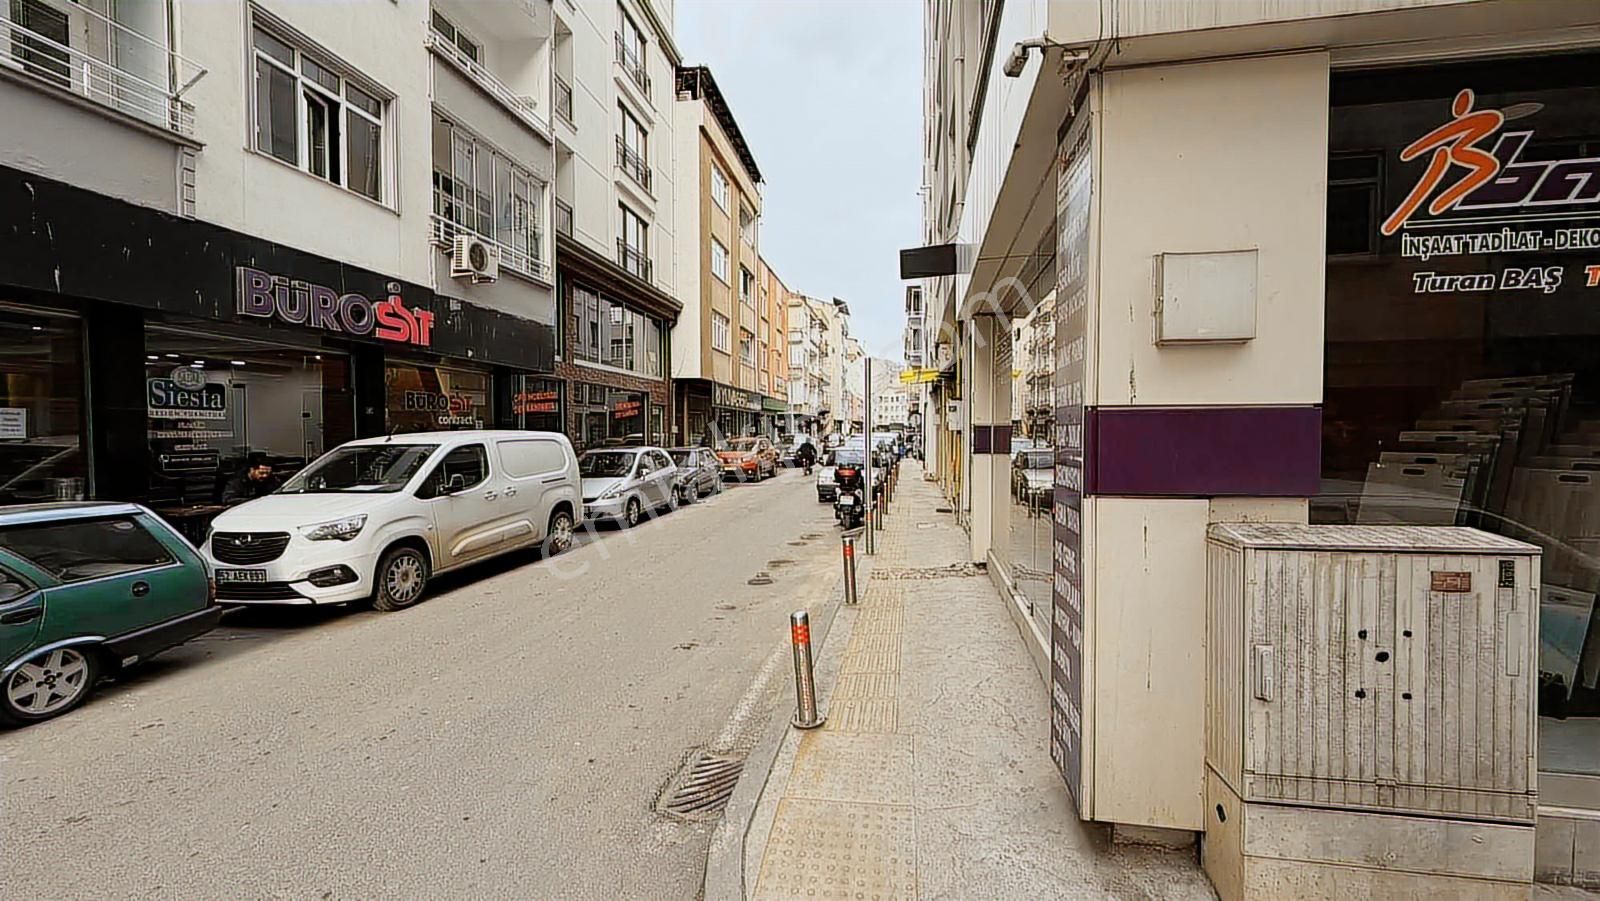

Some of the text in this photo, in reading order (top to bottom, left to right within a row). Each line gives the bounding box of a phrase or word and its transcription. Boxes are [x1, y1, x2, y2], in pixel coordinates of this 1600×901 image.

[1402, 233, 1465, 261] İNŞAAT
[1468, 227, 1542, 253] TADİLAT
[1413, 272, 1495, 293] Turan
[1500, 266, 1563, 293] BAŞ
[151, 381, 223, 408] Siesta
